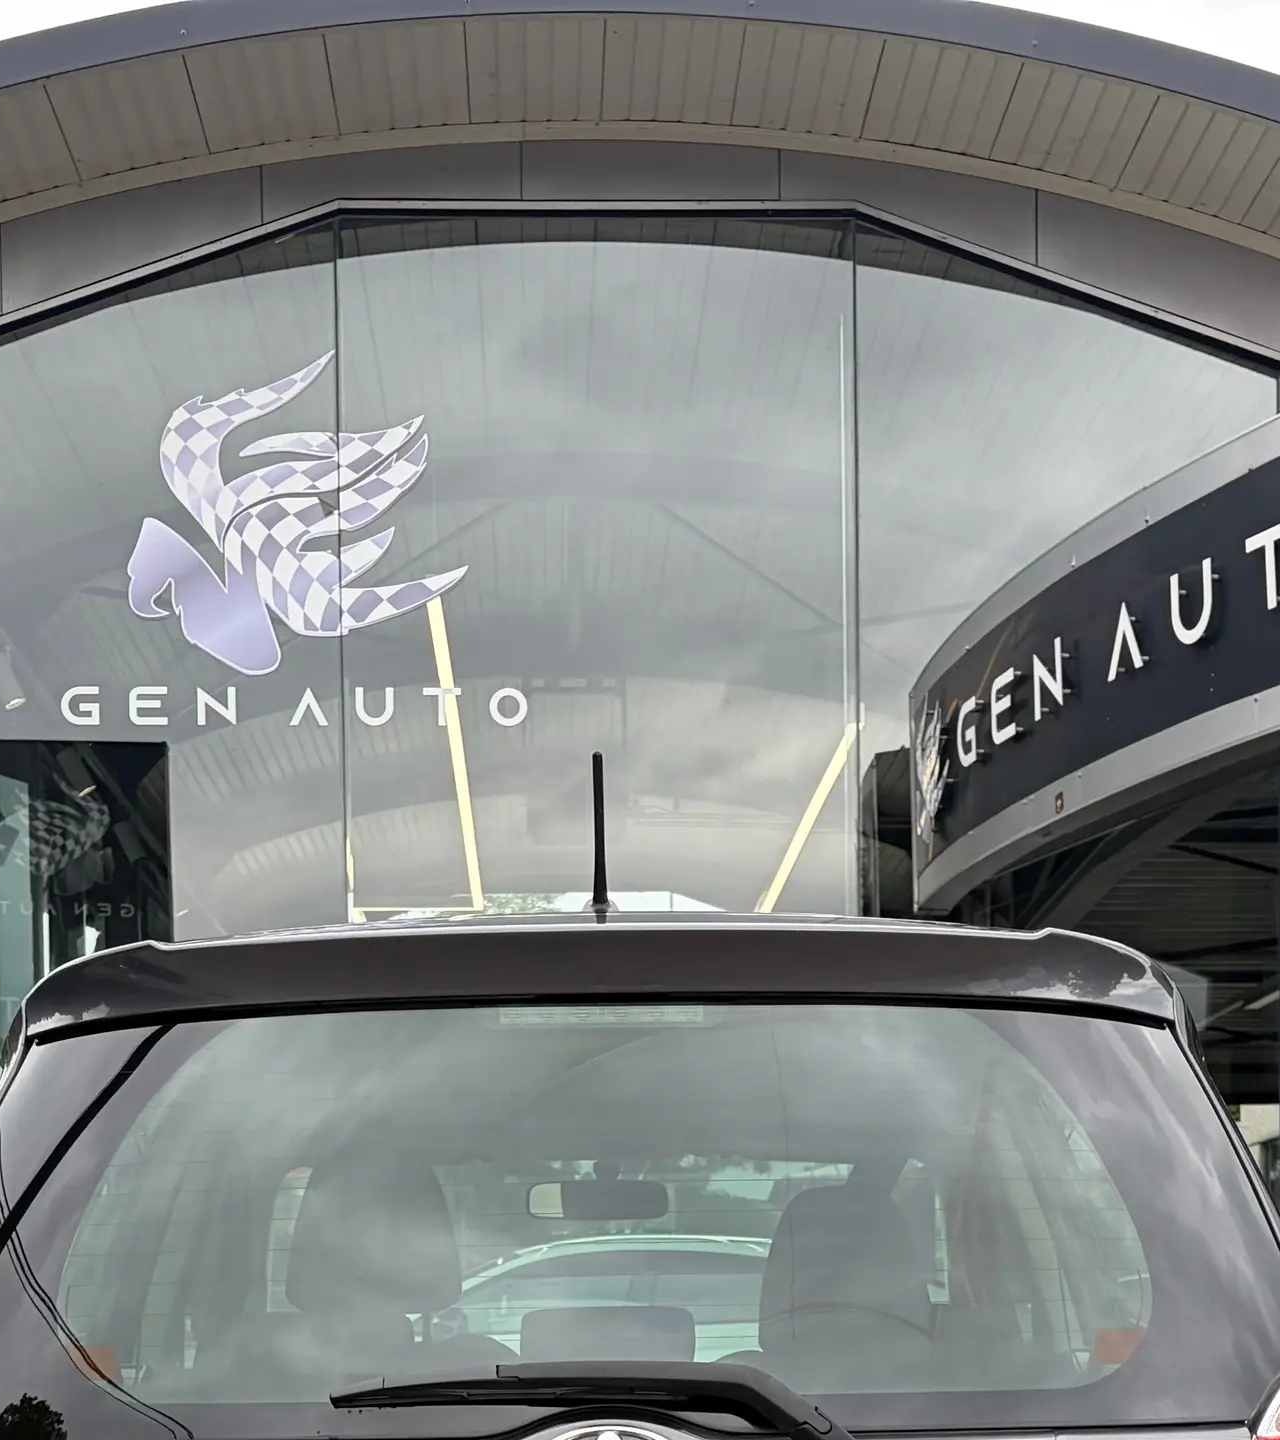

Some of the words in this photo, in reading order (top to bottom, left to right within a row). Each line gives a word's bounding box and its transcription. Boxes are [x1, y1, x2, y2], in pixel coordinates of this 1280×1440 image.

[60, 685, 237, 727] GEN
[289, 686, 528, 727] AUTO
[957, 636, 1064, 768] GEN
